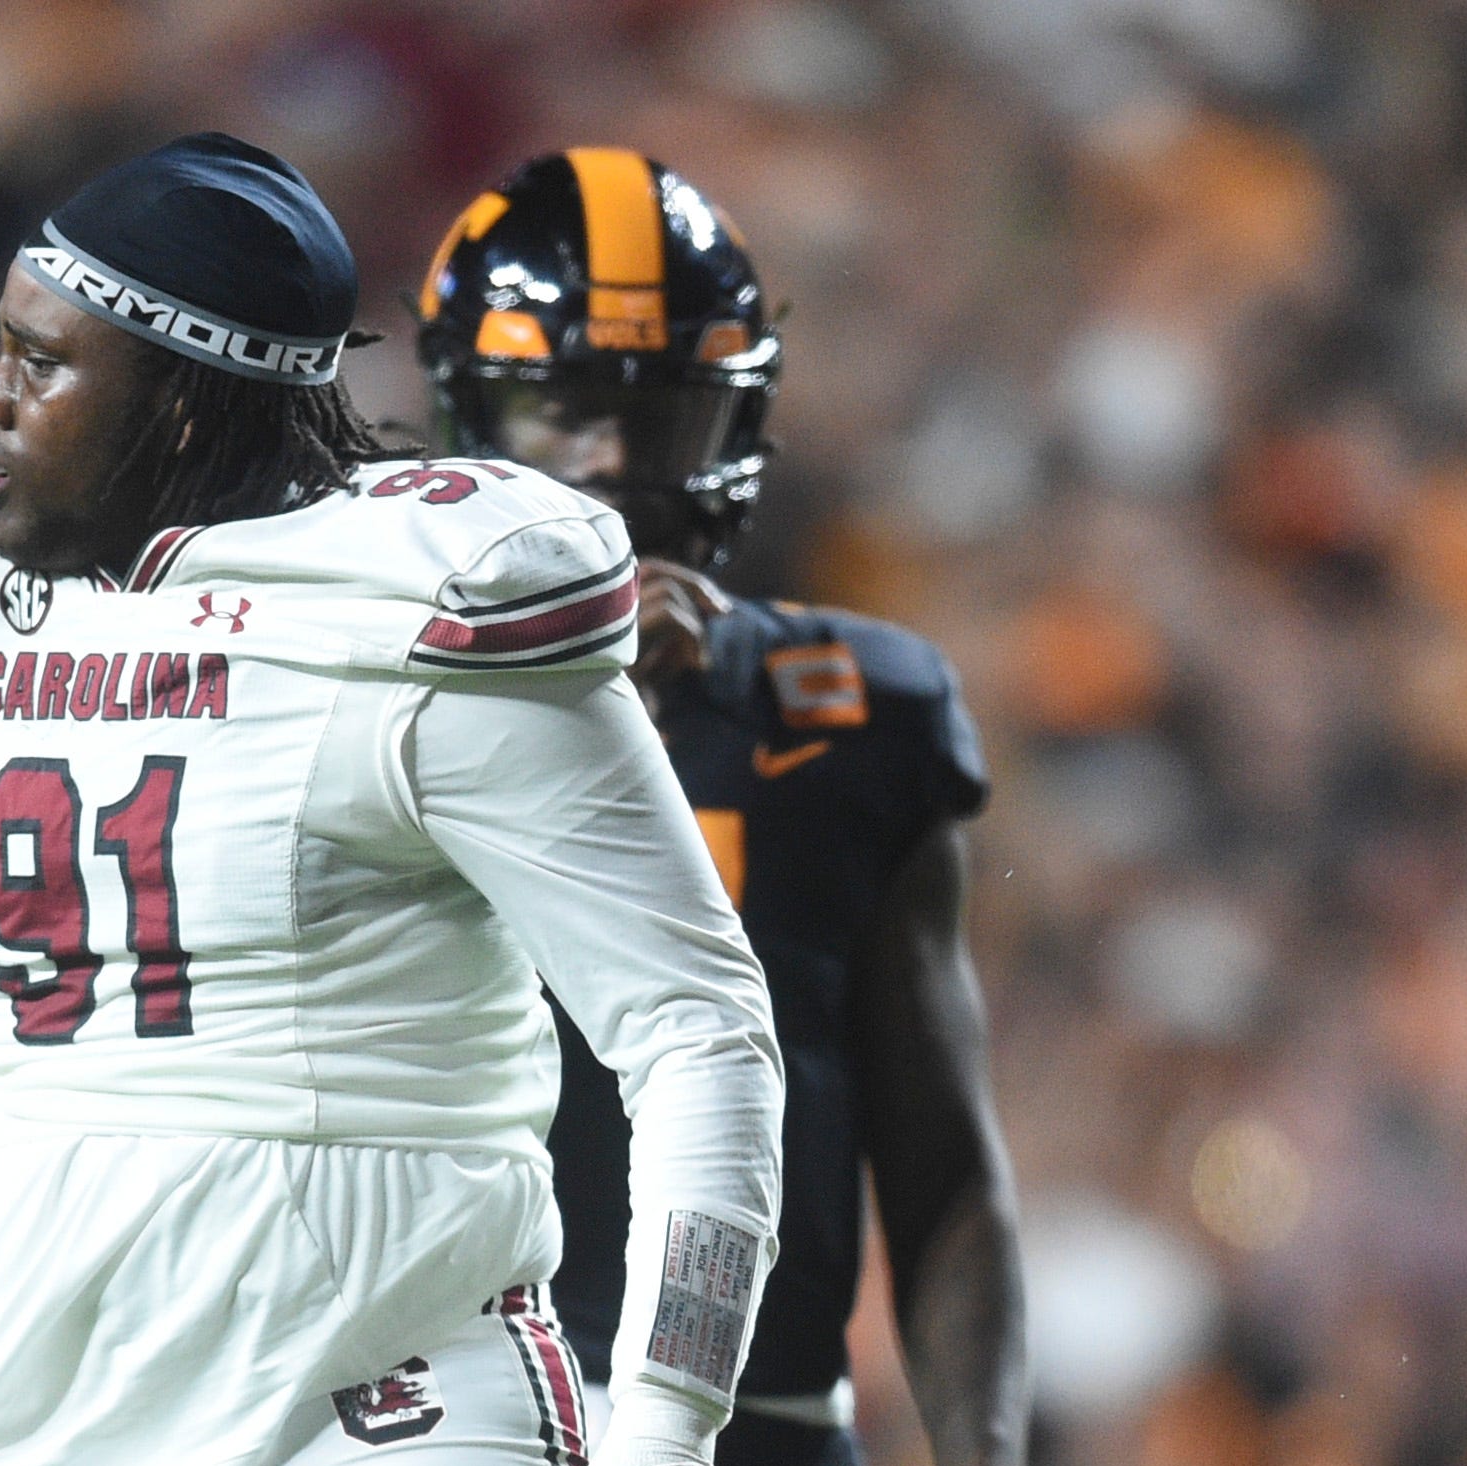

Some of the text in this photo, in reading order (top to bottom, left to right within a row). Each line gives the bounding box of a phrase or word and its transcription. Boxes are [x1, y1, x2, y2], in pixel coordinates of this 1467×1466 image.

[25, 247, 323, 375] ARMOUR
[2, 568, 50, 632] SEC
[695, 1242, 710, 1273] WIDE
